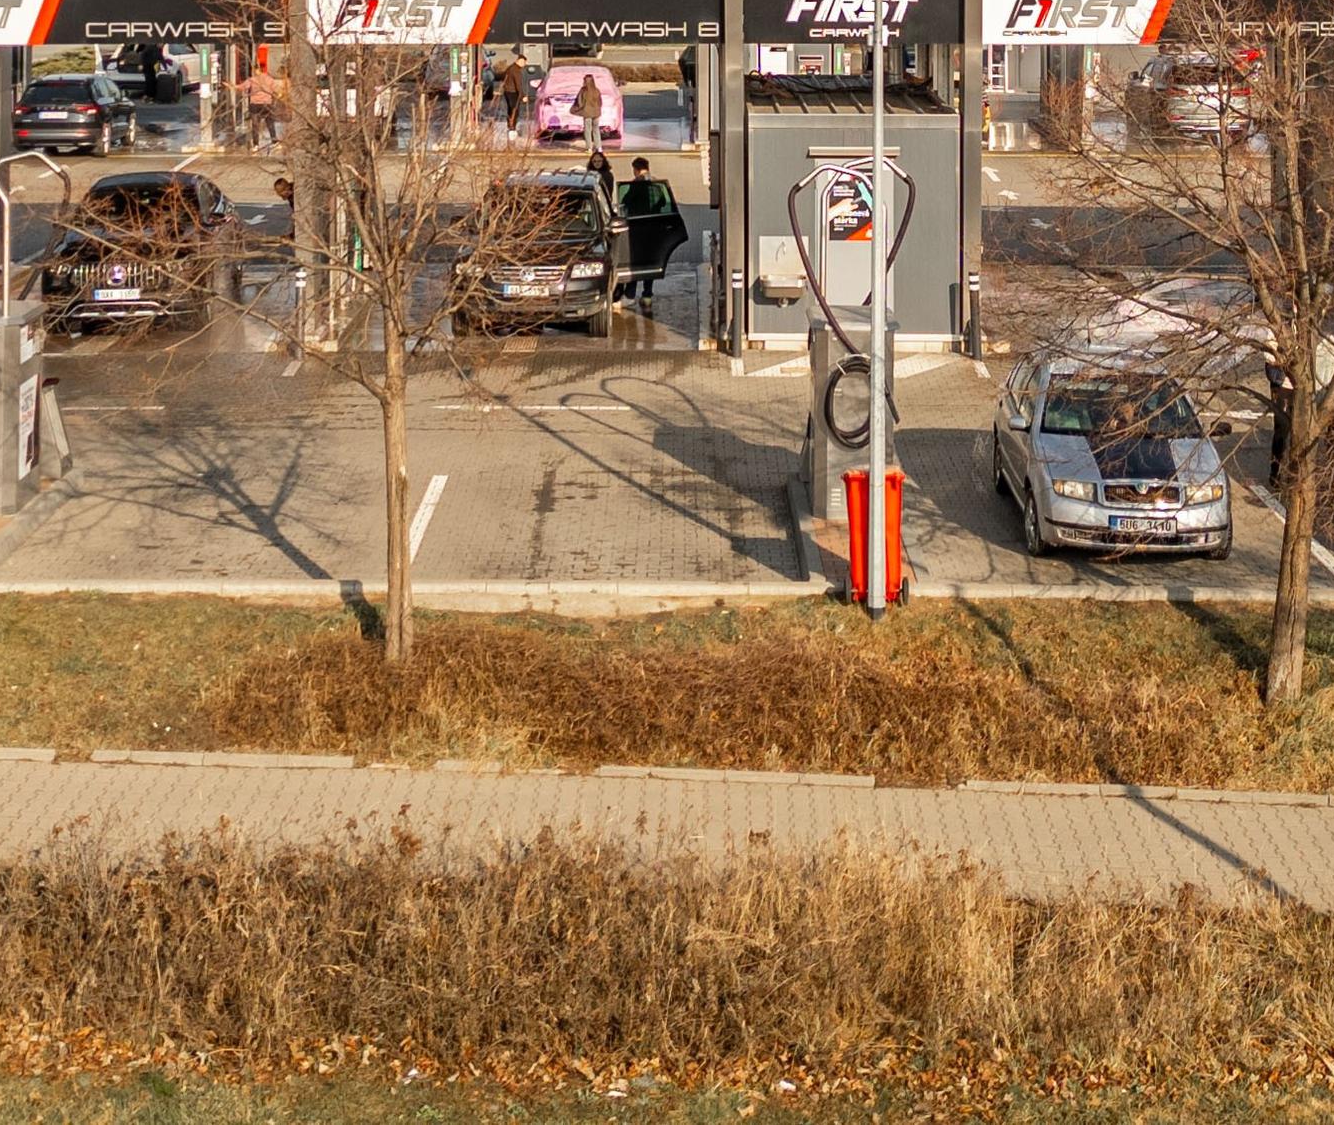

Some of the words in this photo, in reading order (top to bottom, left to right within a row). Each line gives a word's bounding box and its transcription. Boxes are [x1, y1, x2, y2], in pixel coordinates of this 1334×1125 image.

[85, 21, 253, 38] CARWASH
[264, 21, 286, 38] 9
[523, 21, 687, 37] CARWASH
